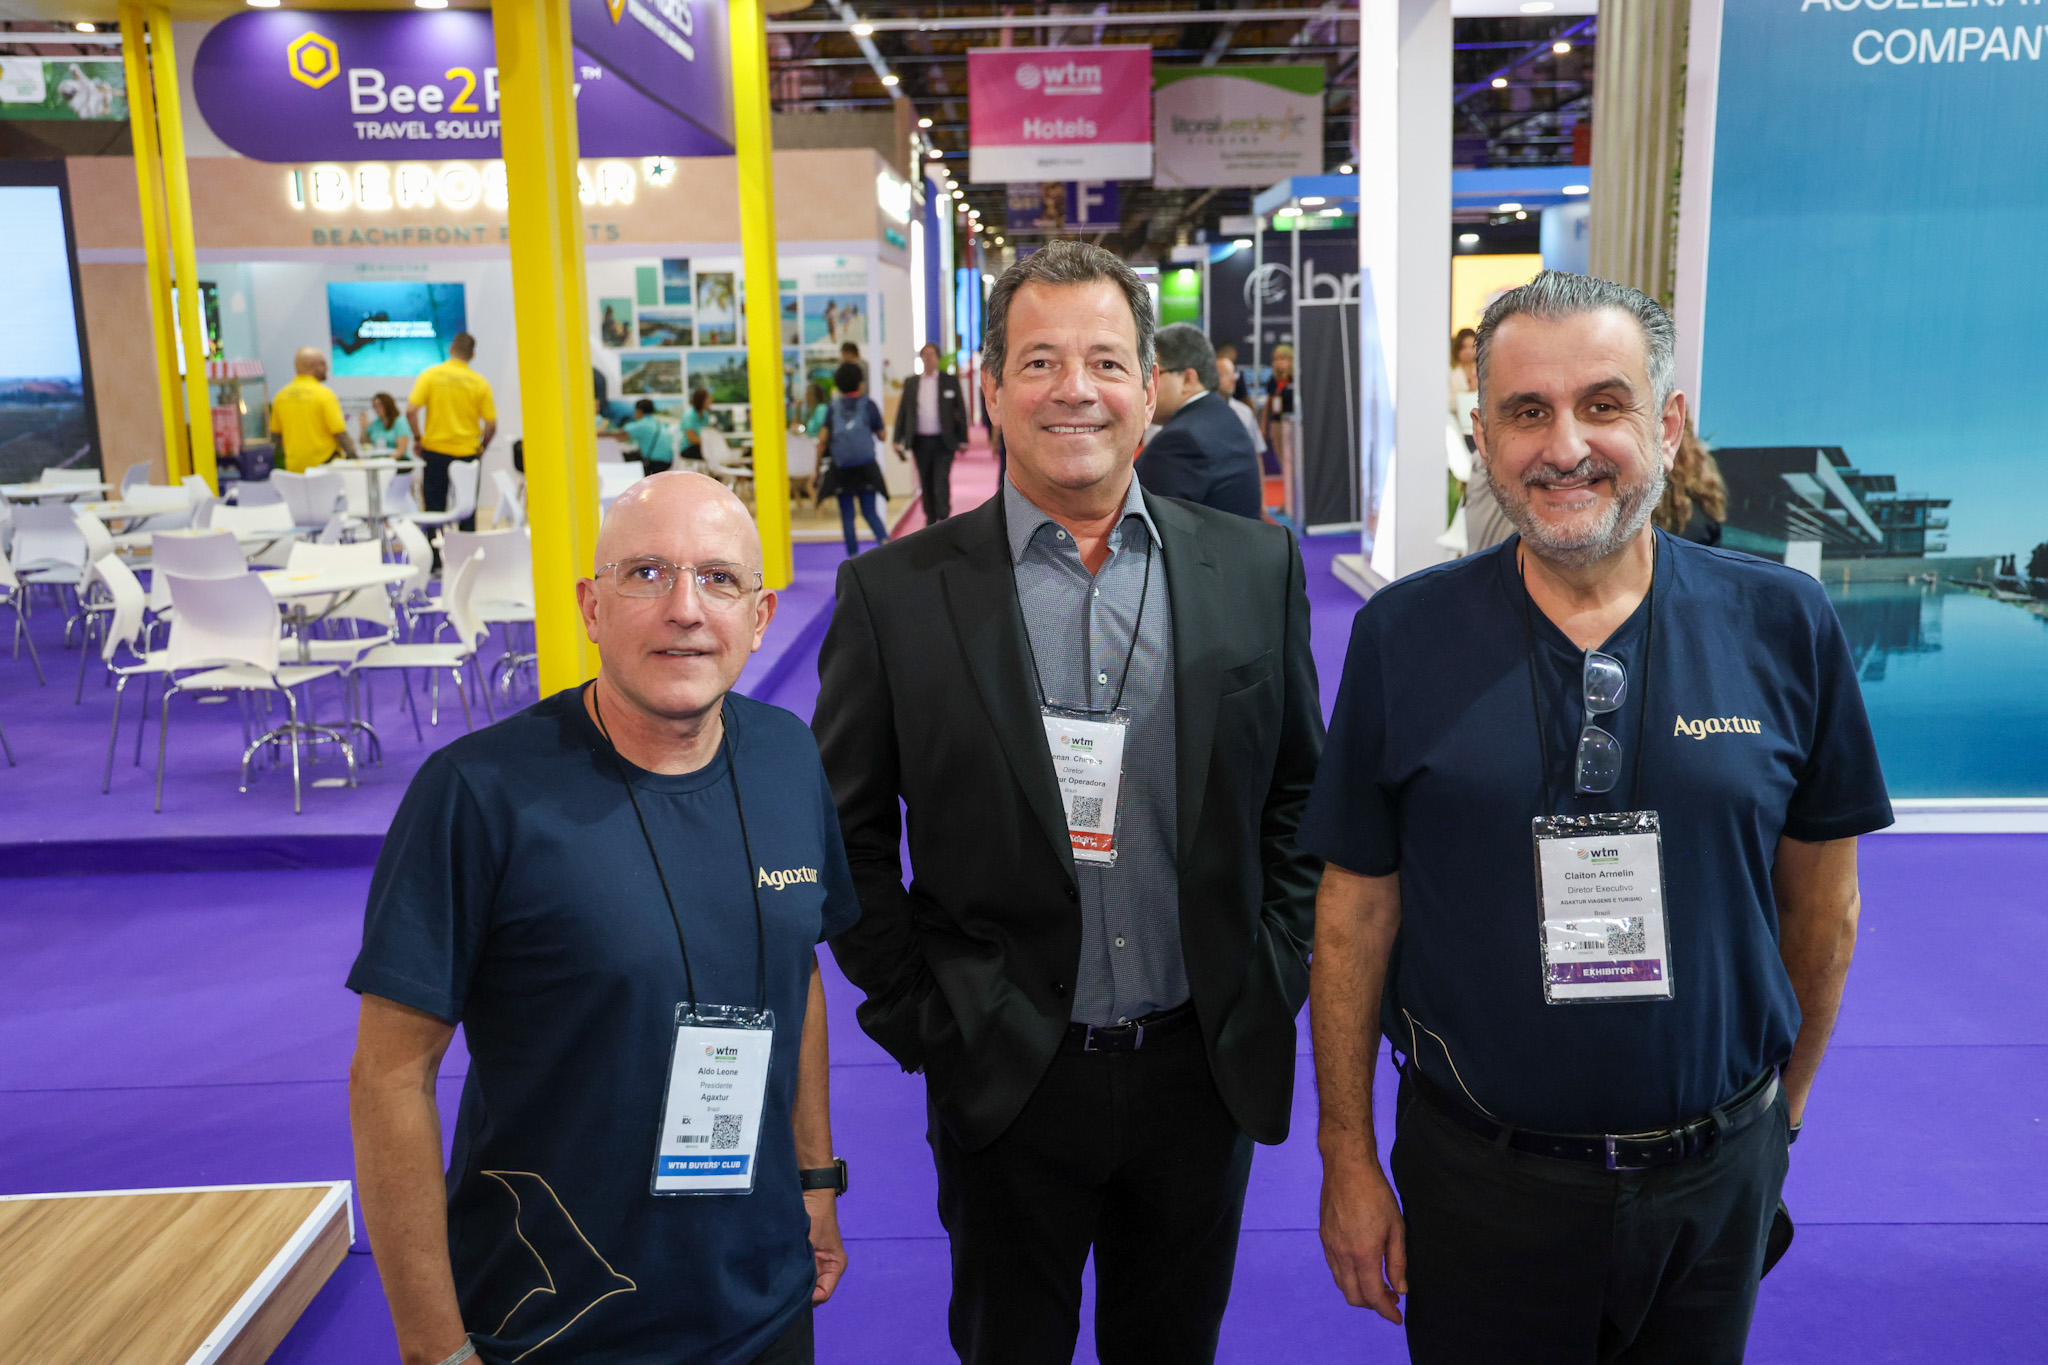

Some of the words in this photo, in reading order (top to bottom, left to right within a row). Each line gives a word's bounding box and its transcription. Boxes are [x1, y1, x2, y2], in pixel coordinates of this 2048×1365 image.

[1852, 25, 2048, 65] COMPAN
[1043, 60, 1101, 84] wtm
[353, 120, 433, 140] TRAVEL
[435, 120, 502, 139] SOLUT
[1023, 117, 1097, 139] Hotels
[290, 162, 635, 209] IBEROSAR
[312, 224, 488, 246] BEACHFRONT
[1674, 714, 1761, 740] Agaxtur
[1072, 737, 1093, 746] wtm
[1063, 766, 1084, 775] Diretor
[1068, 777, 1106, 787] Operadora
[1591, 847, 1618, 857] wtm
[757, 866, 817, 891] Agaxtur
[1564, 872, 1597, 880] Claiton
[1599, 869, 1634, 878] Armelin
[1567, 886, 1594, 894] Diretor
[1595, 884, 1633, 893] Executivo
[1583, 967, 1634, 977] EXHIBITOR
[716, 1046, 738, 1056] wtm
[698, 1067, 715, 1075] Aldo
[716, 1067, 739, 1076] Leone
[700, 1081, 733, 1090] Presidente
[701, 1093, 729, 1103] Agaxtur
[668, 1161, 688, 1169] WTM
[721, 1161, 741, 1169] CLUB
